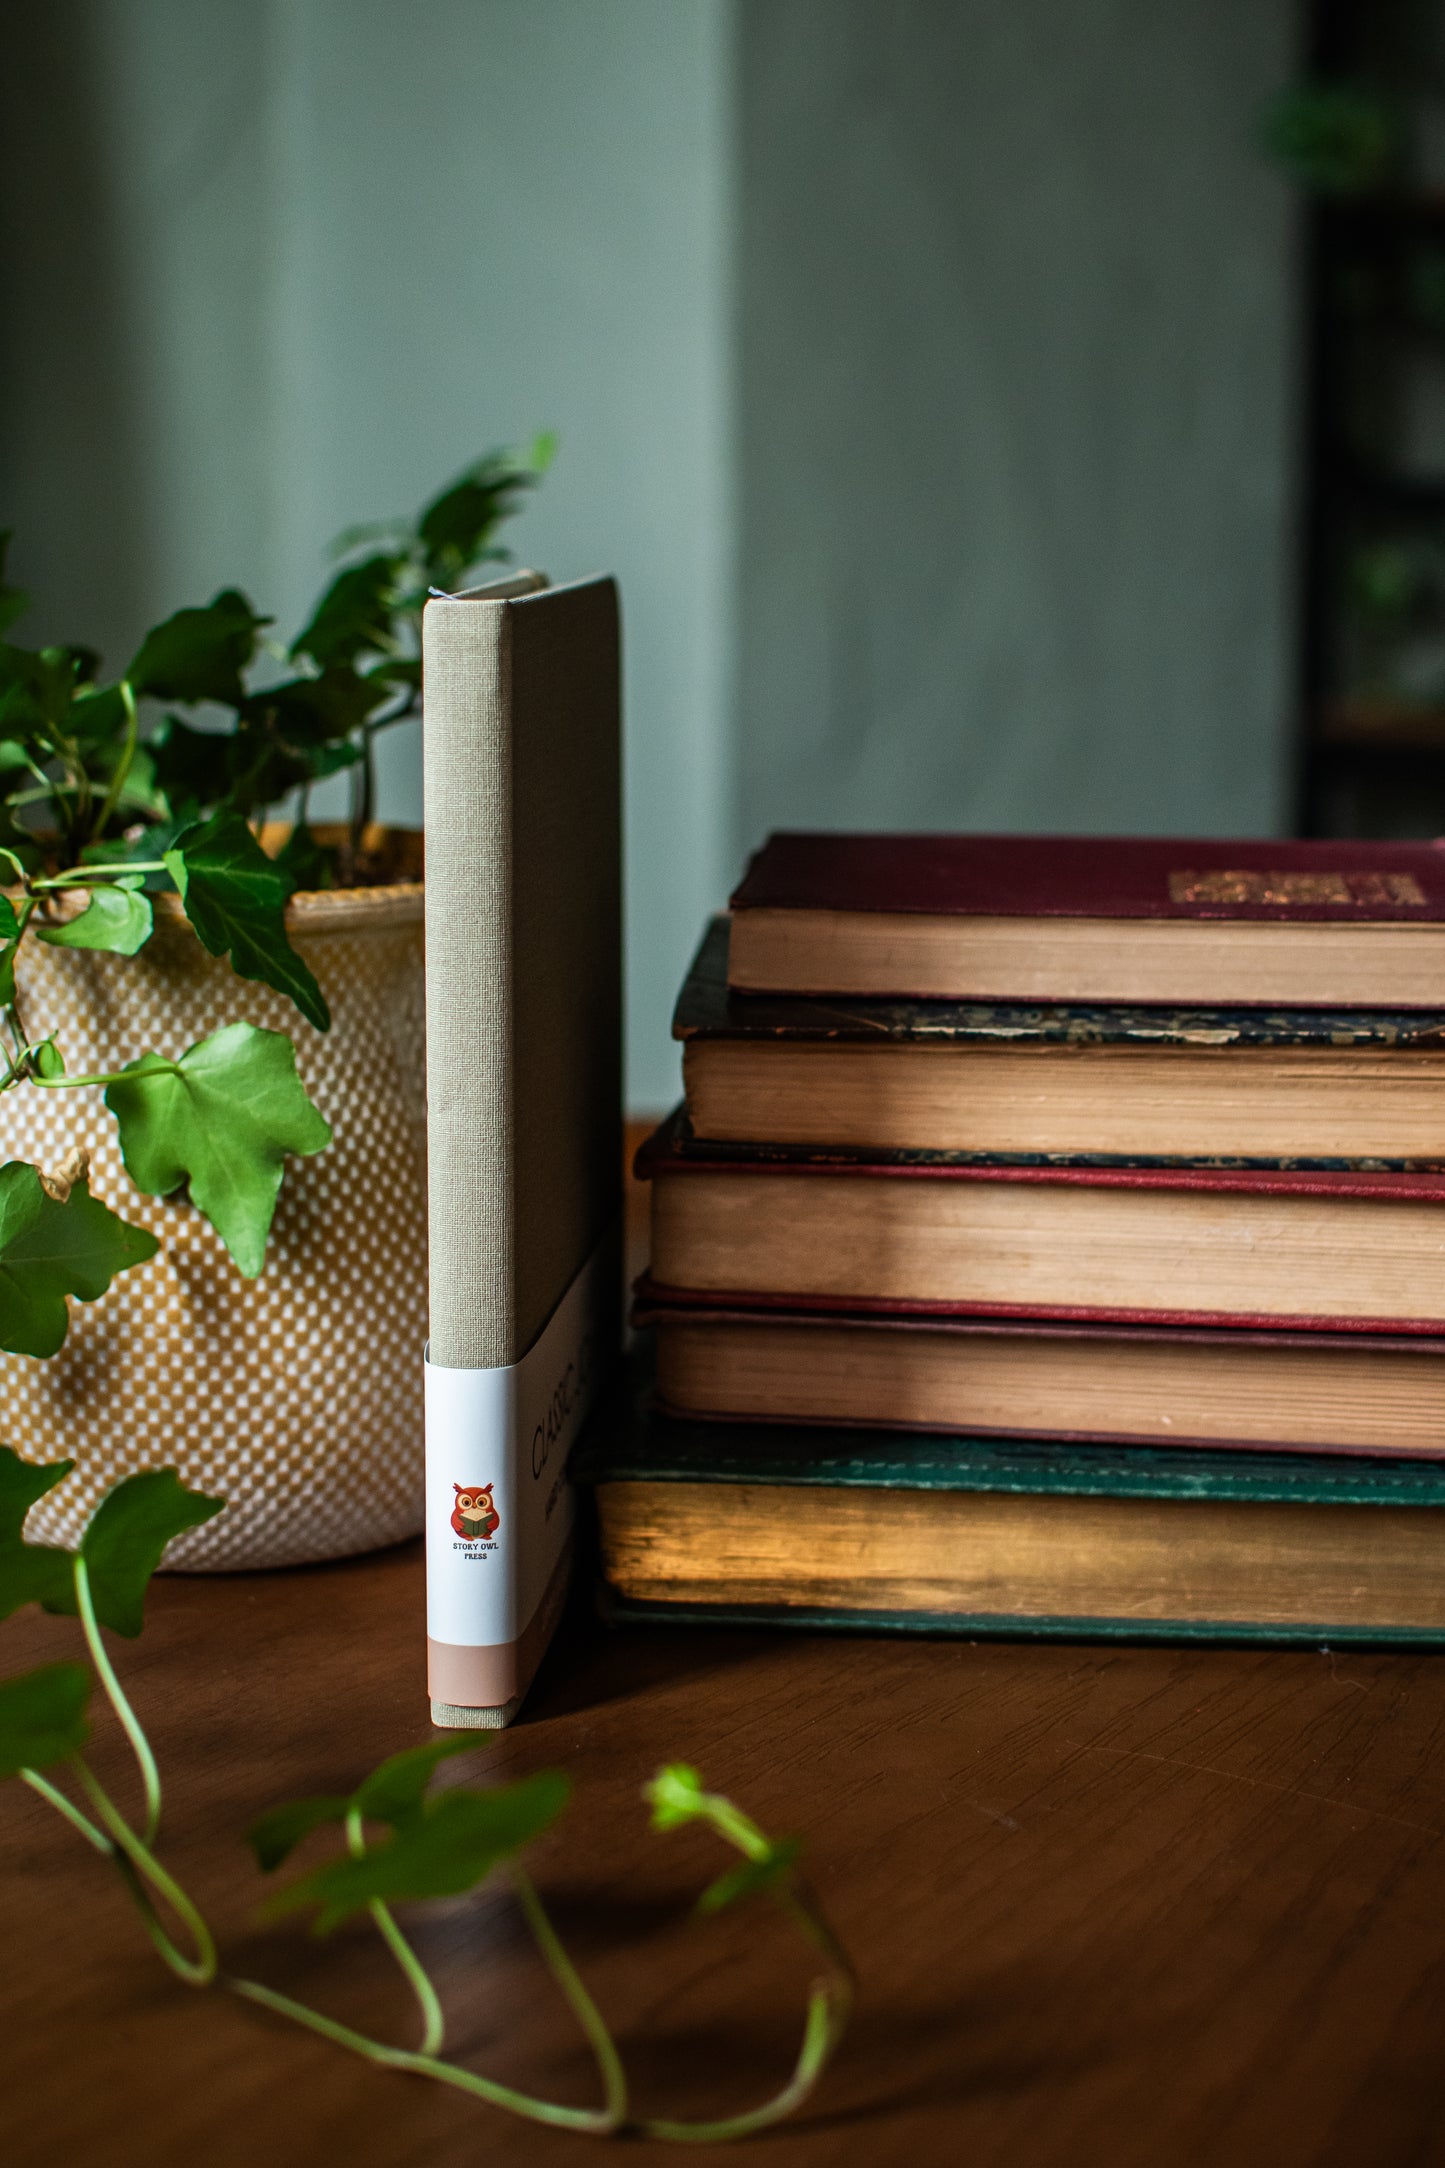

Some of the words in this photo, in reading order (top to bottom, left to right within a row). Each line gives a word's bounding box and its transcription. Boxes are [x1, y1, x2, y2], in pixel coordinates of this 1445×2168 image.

[453, 1542, 479, 1550] STORY
[480, 1542, 499, 1550] OWL
[464, 1552, 488, 1560] PRESS
